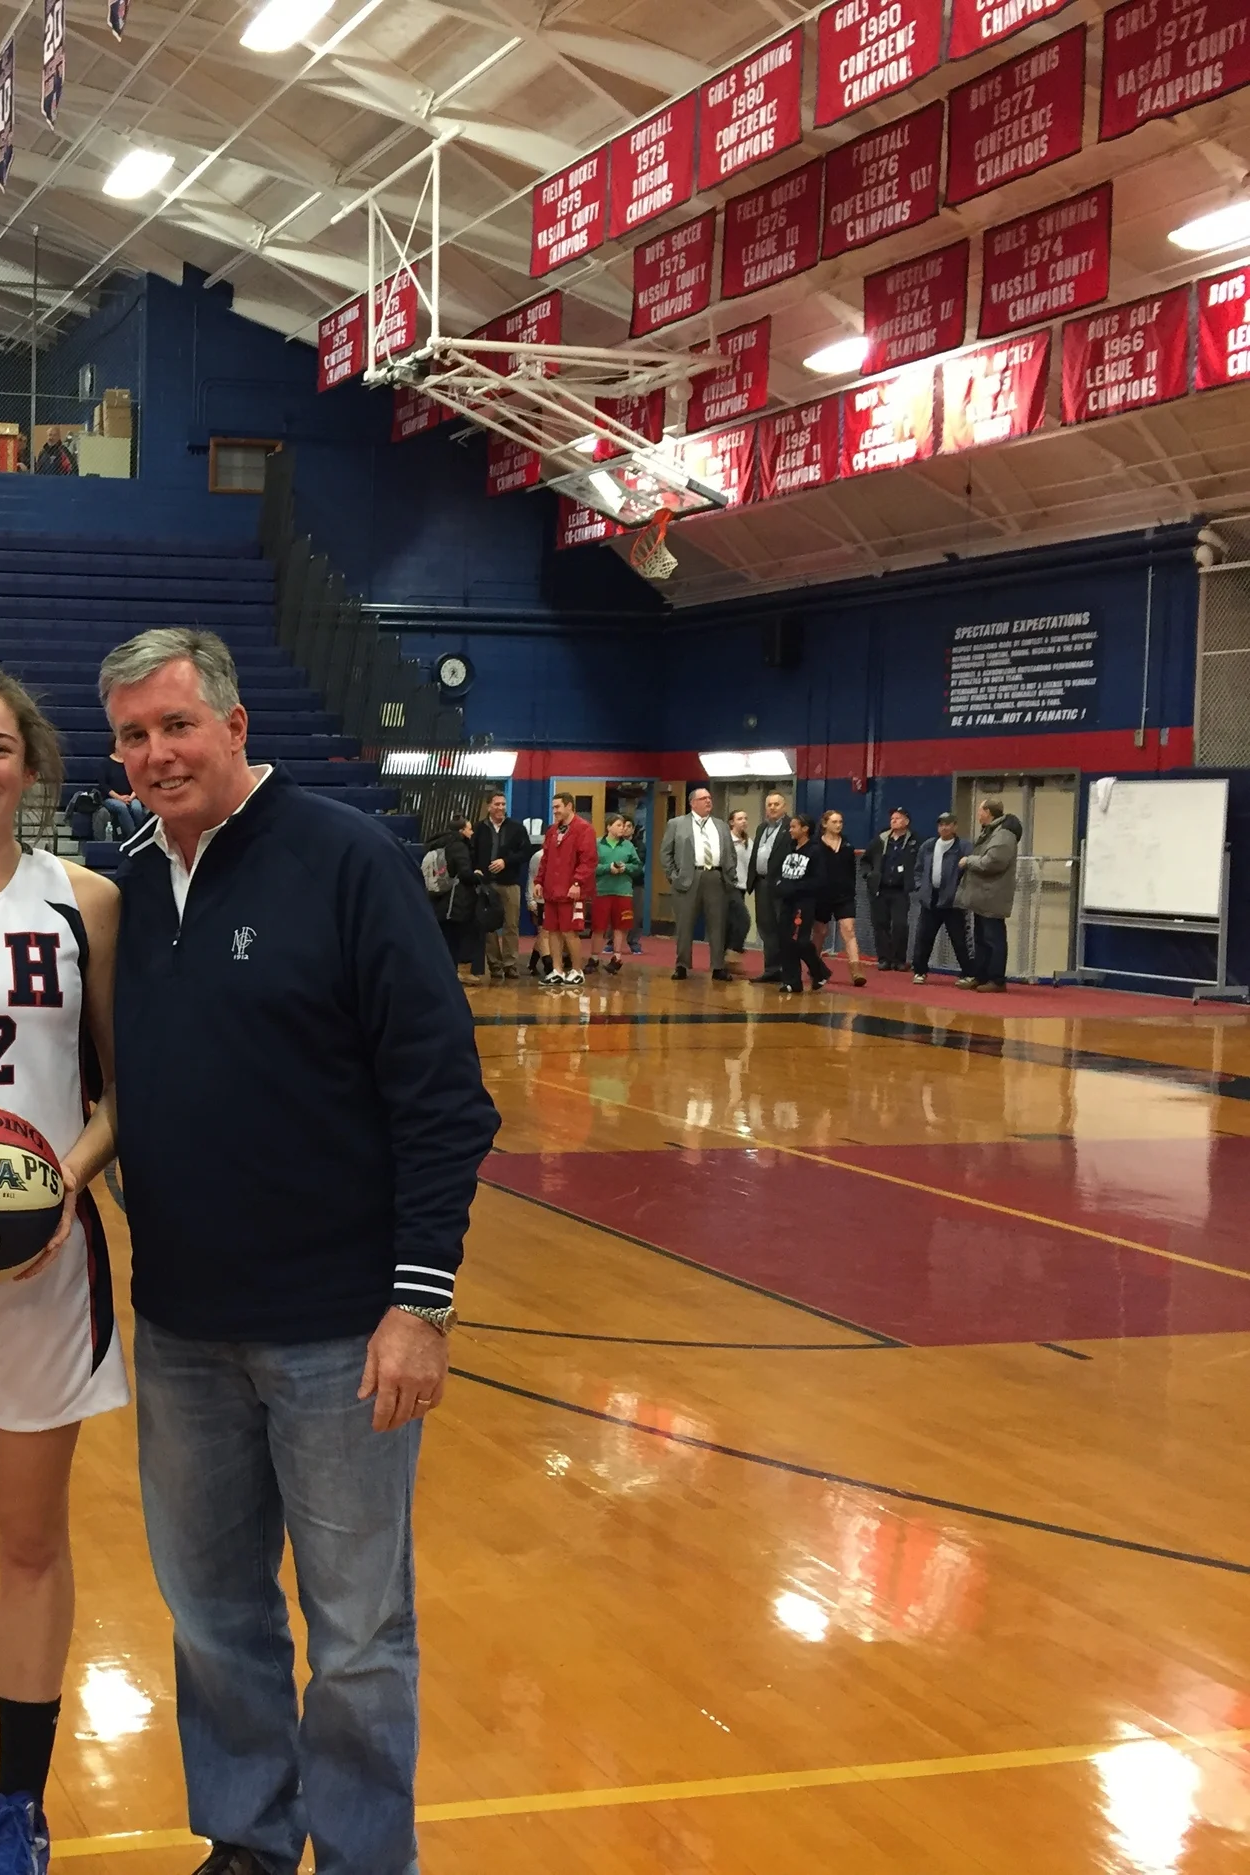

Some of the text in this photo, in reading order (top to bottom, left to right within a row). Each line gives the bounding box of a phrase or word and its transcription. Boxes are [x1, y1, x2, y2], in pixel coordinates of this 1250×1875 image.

[835, 0, 869, 31] GIRLS
[859, 3, 901, 46] 1980
[1156, 5, 1208, 51] 1977
[1186, 18, 1247, 67] COUNTY
[708, 74, 736, 107] GIRLS
[731, 83, 764, 119] 1980
[993, 84, 1035, 125] 1977
[630, 112, 673, 155] FOOTBALL
[715, 99, 777, 153] CONFERENCE
[974, 102, 1053, 161] CONFERENCE
[636, 141, 665, 173] 1979
[720, 129, 775, 174] CHAMPIONS
[632, 169, 669, 199] DIVISION
[862, 154, 899, 187] 1976
[556, 191, 582, 219] 1979
[626, 183, 673, 224] CHAMPIONS
[755, 208, 787, 238] 1976
[659, 252, 686, 278] 1976
[743, 250, 796, 288] CHAMPIONS
[1022, 235, 1064, 269] 1974
[1047, 248, 1095, 284] COUNTY
[896, 284, 930, 314] 1974
[1008, 281, 1075, 323] CHAMPIONS
[1088, 300, 1162, 342] BOYS GOLF
[1103, 330, 1145, 360] 1966
[1086, 356, 1135, 389] LEAGUE
[1088, 376, 1157, 412] CHAMPIONS
[801, 404, 822, 427] GOLF
[785, 427, 811, 450] 1965
[954, 611, 1090, 640] SPECTATOR EXPECTATIONS
[951, 716, 964, 726] BE
[965, 715, 973, 726] A
[1024, 712, 1032, 723] A
[1035, 708, 1078, 722] FANATIC
